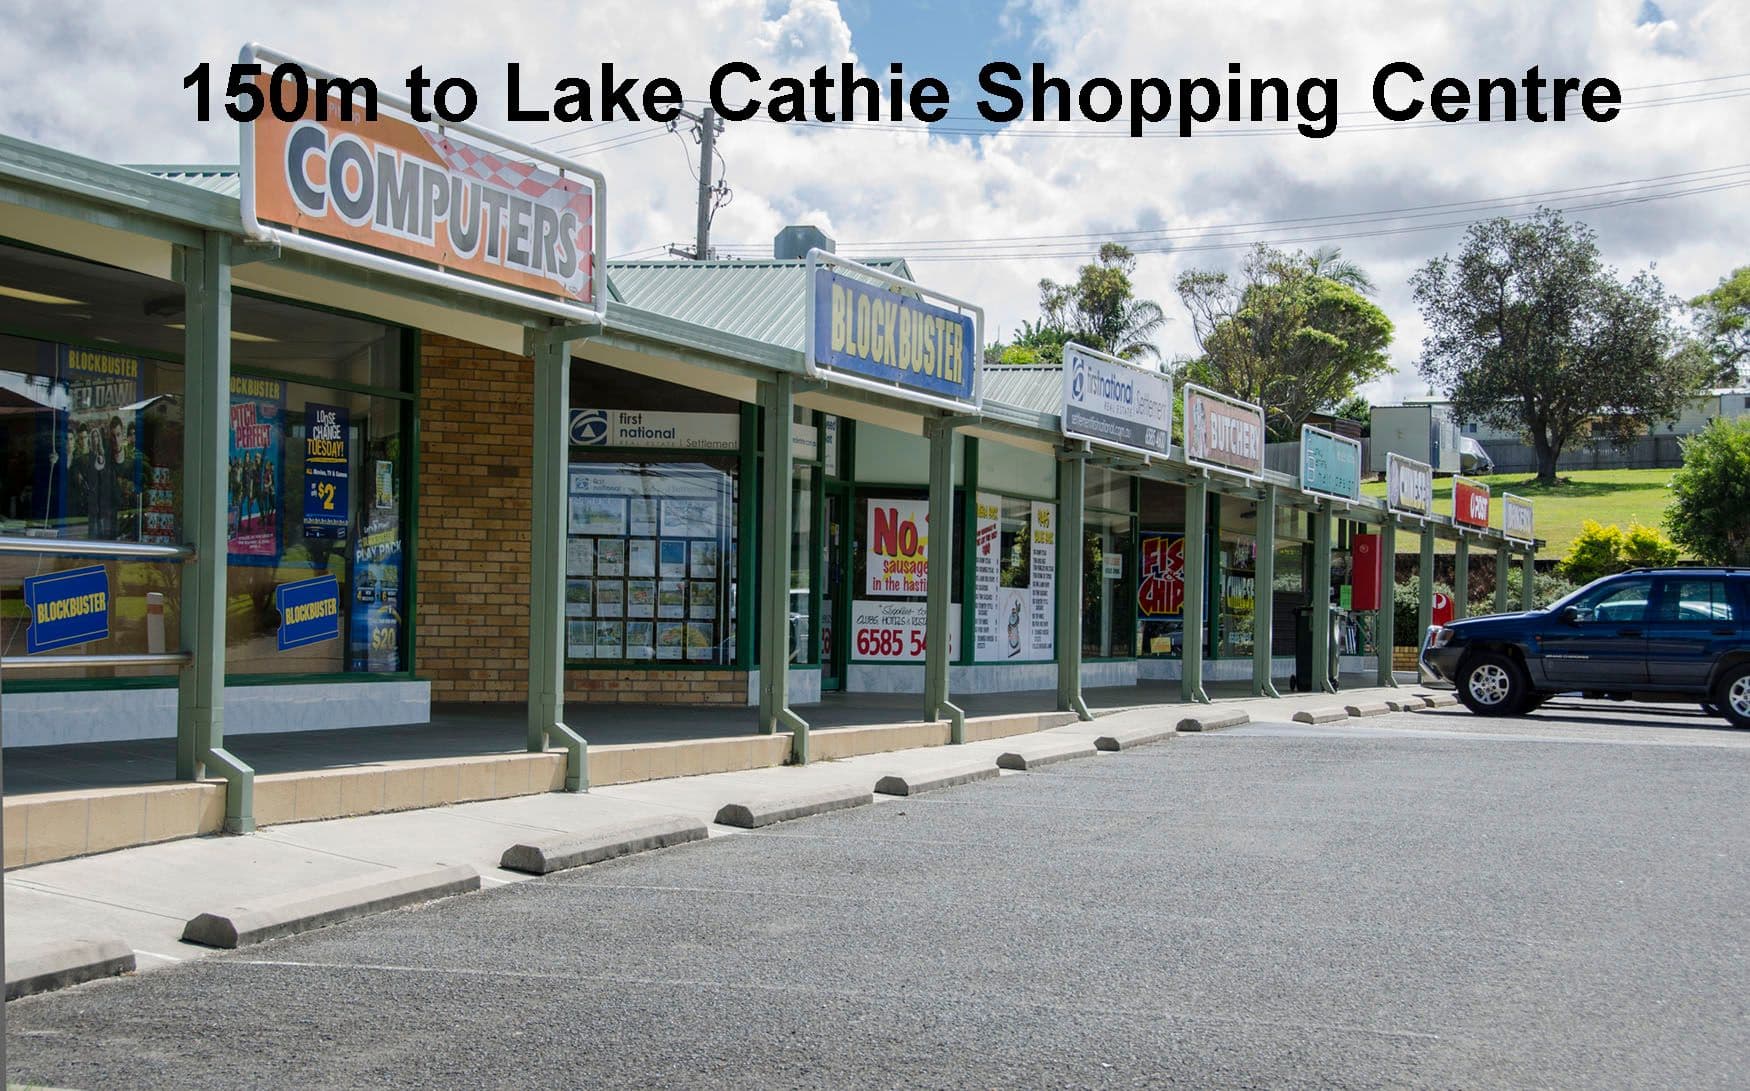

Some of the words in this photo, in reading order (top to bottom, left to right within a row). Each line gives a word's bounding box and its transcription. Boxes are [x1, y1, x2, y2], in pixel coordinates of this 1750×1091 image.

[286, 121, 579, 281] COMPUTERS
[831, 283, 964, 384] BLOCKBUSTER
[69, 350, 138, 378] BLOCKBUSTER
[231, 375, 280, 400] OCKBUSTER
[231, 402, 256, 430] PITCH
[620, 412, 642, 425] first
[235, 424, 272, 448] PERFECT
[313, 425, 341, 441] CHANGE
[620, 427, 676, 440] national
[686, 438, 738, 449] Settlement
[307, 438, 345, 458] TUESDAY!
[874, 507, 929, 558] No.
[1143, 536, 1185, 577] FIS
[873, 577, 882, 591] in
[885, 576, 900, 591] the
[1138, 575, 1185, 616] CHIP
[37, 592, 106, 624] BLOCKBUSTER
[285, 598, 337, 625] BLOCKBUSTER
[857, 628, 904, 656] 6585
